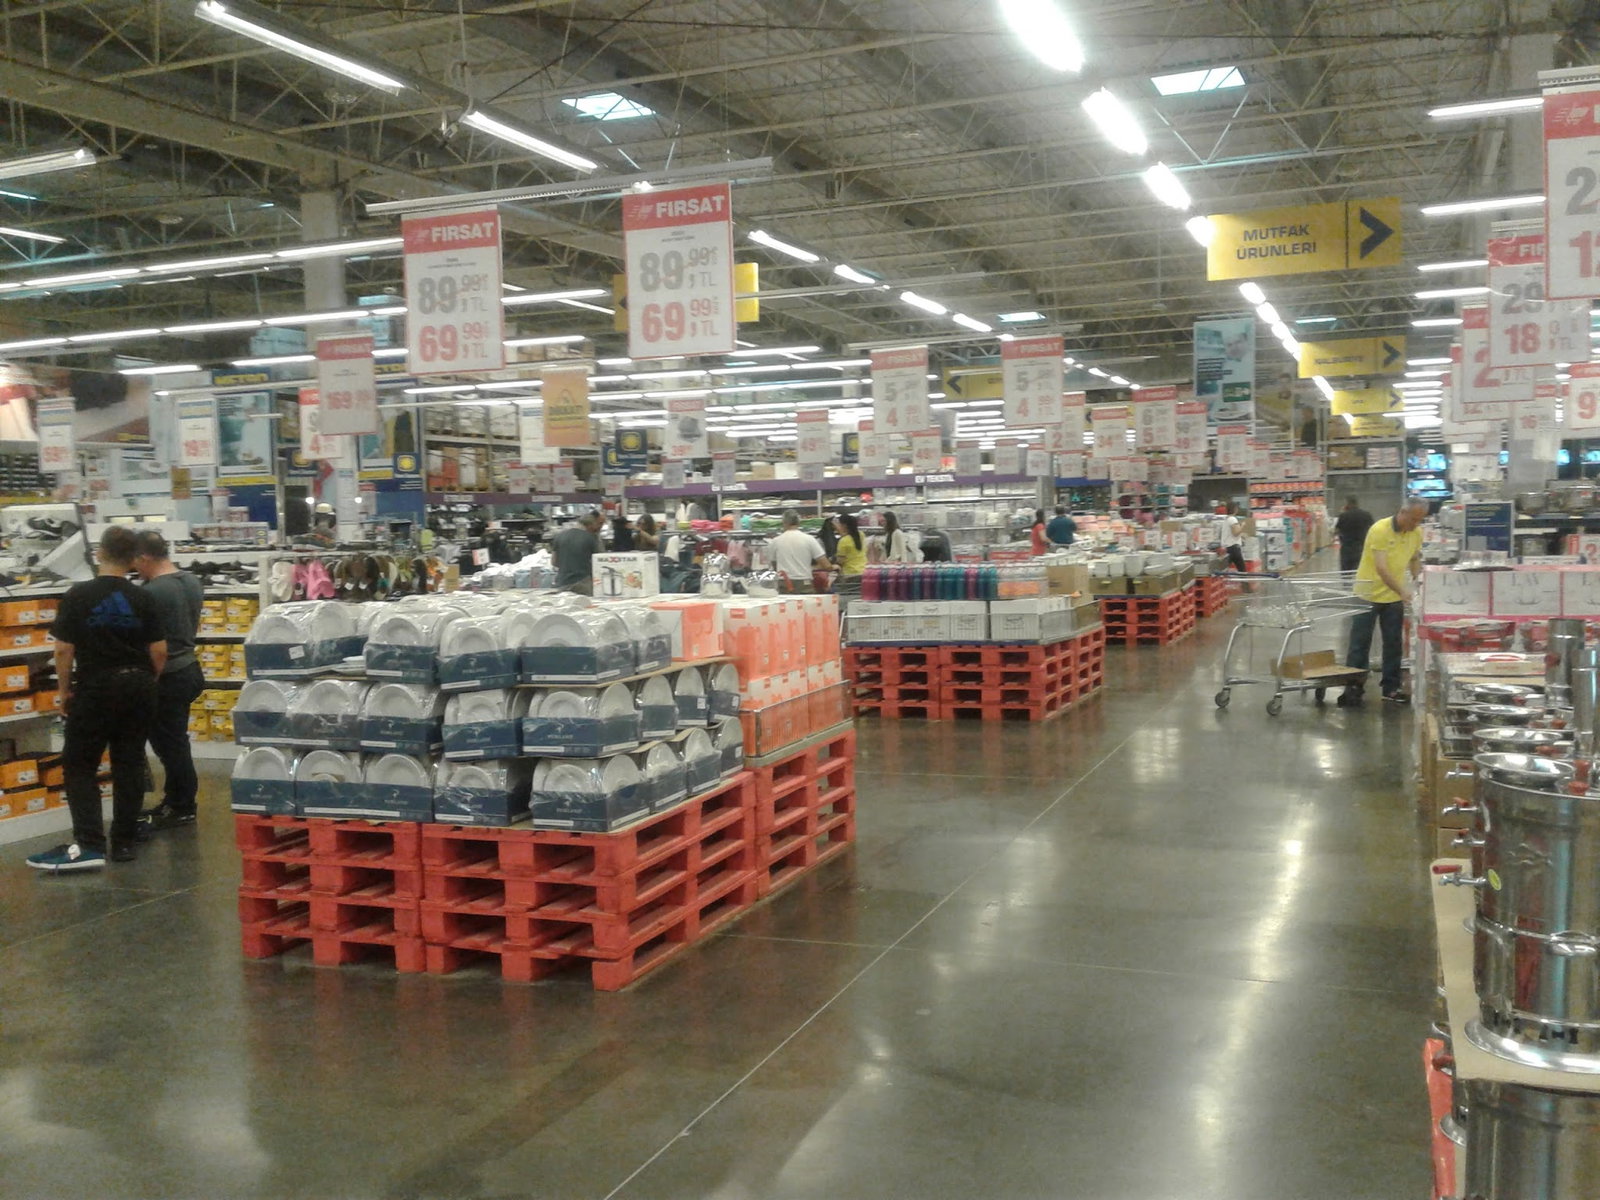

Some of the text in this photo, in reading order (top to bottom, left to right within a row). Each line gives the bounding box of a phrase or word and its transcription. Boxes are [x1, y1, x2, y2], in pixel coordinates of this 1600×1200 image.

[1564, 166, 1600, 217] 2
[656, 195, 725, 218] FIRSAT
[431, 222, 494, 243] FIRSAT
[1243, 224, 1310, 242] MUTFAK
[1568, 230, 1600, 278] 1
